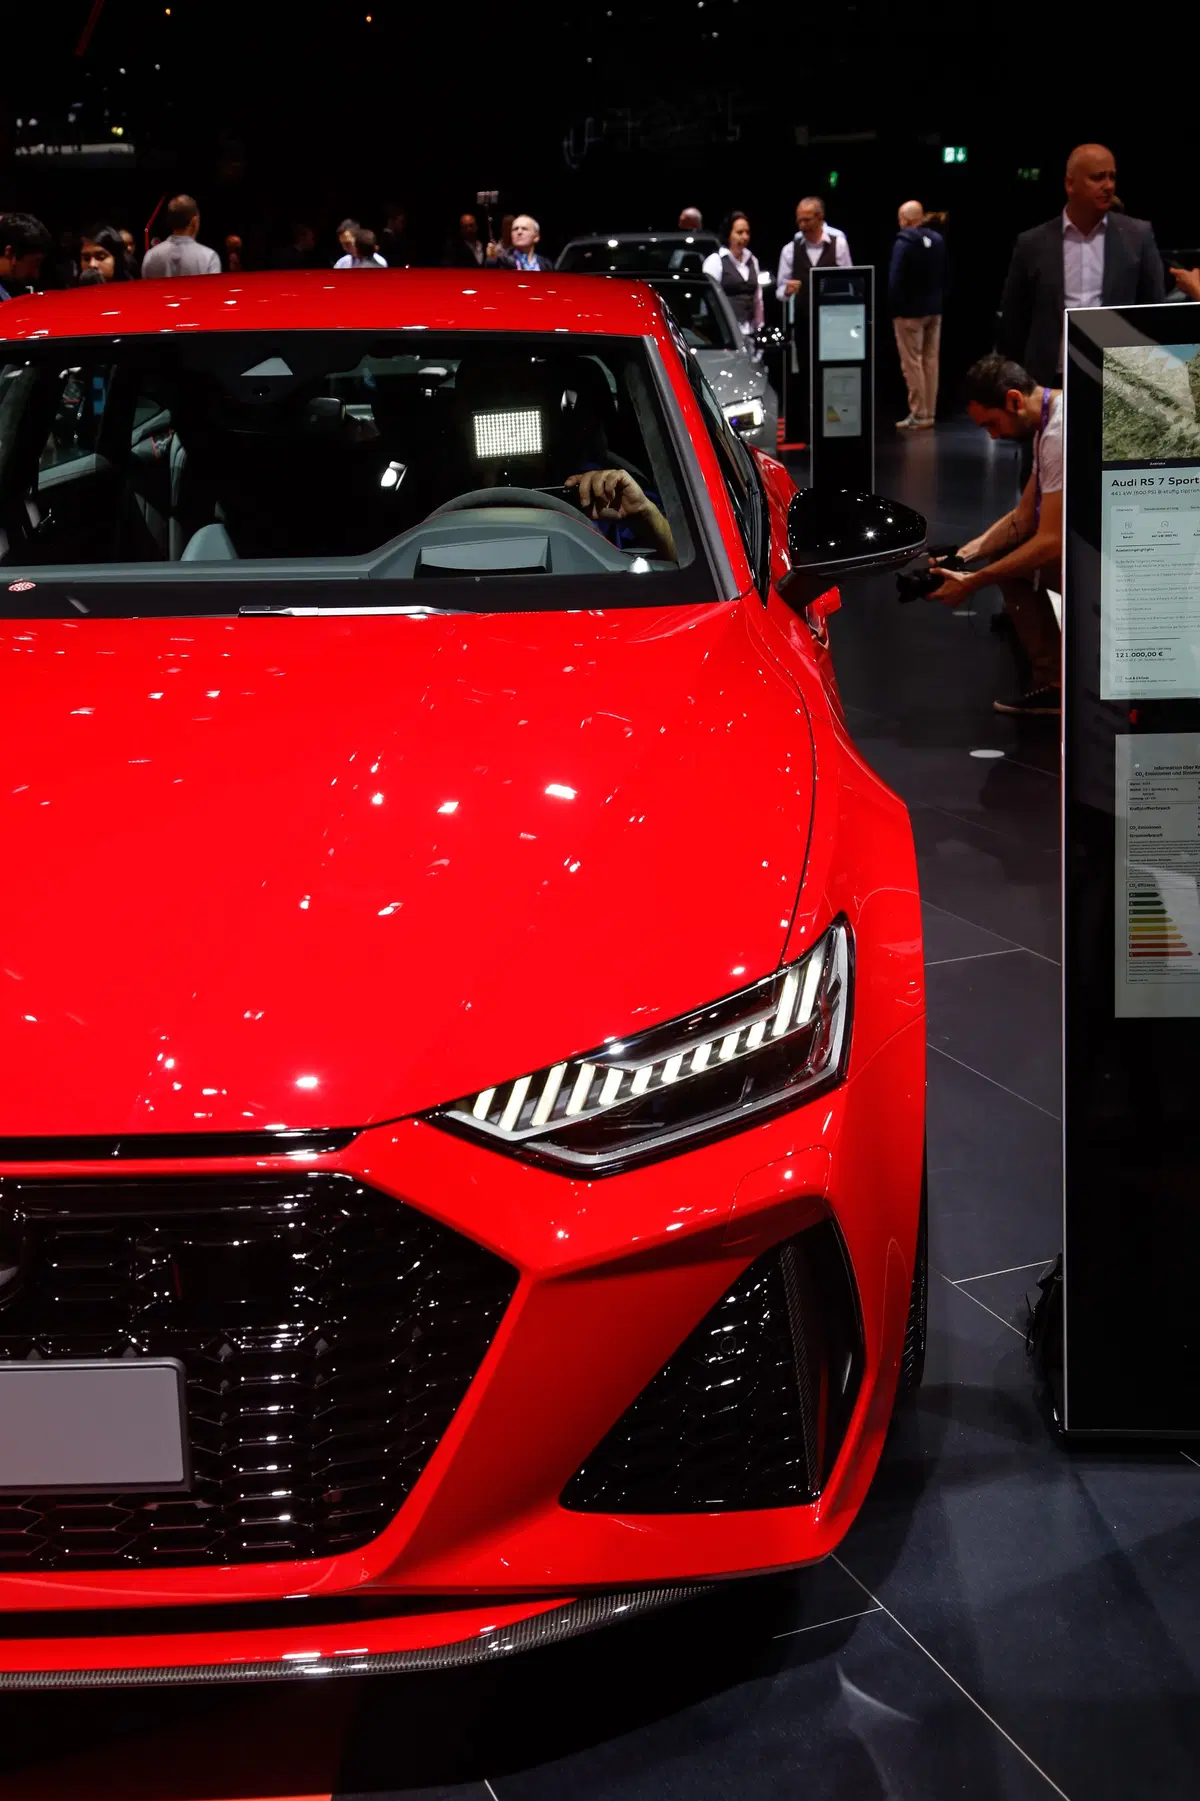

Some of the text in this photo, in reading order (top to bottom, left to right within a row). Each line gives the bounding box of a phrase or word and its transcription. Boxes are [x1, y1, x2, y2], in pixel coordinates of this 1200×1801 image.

[1111, 477, 1200, 487] Audi RS 7 Sport
